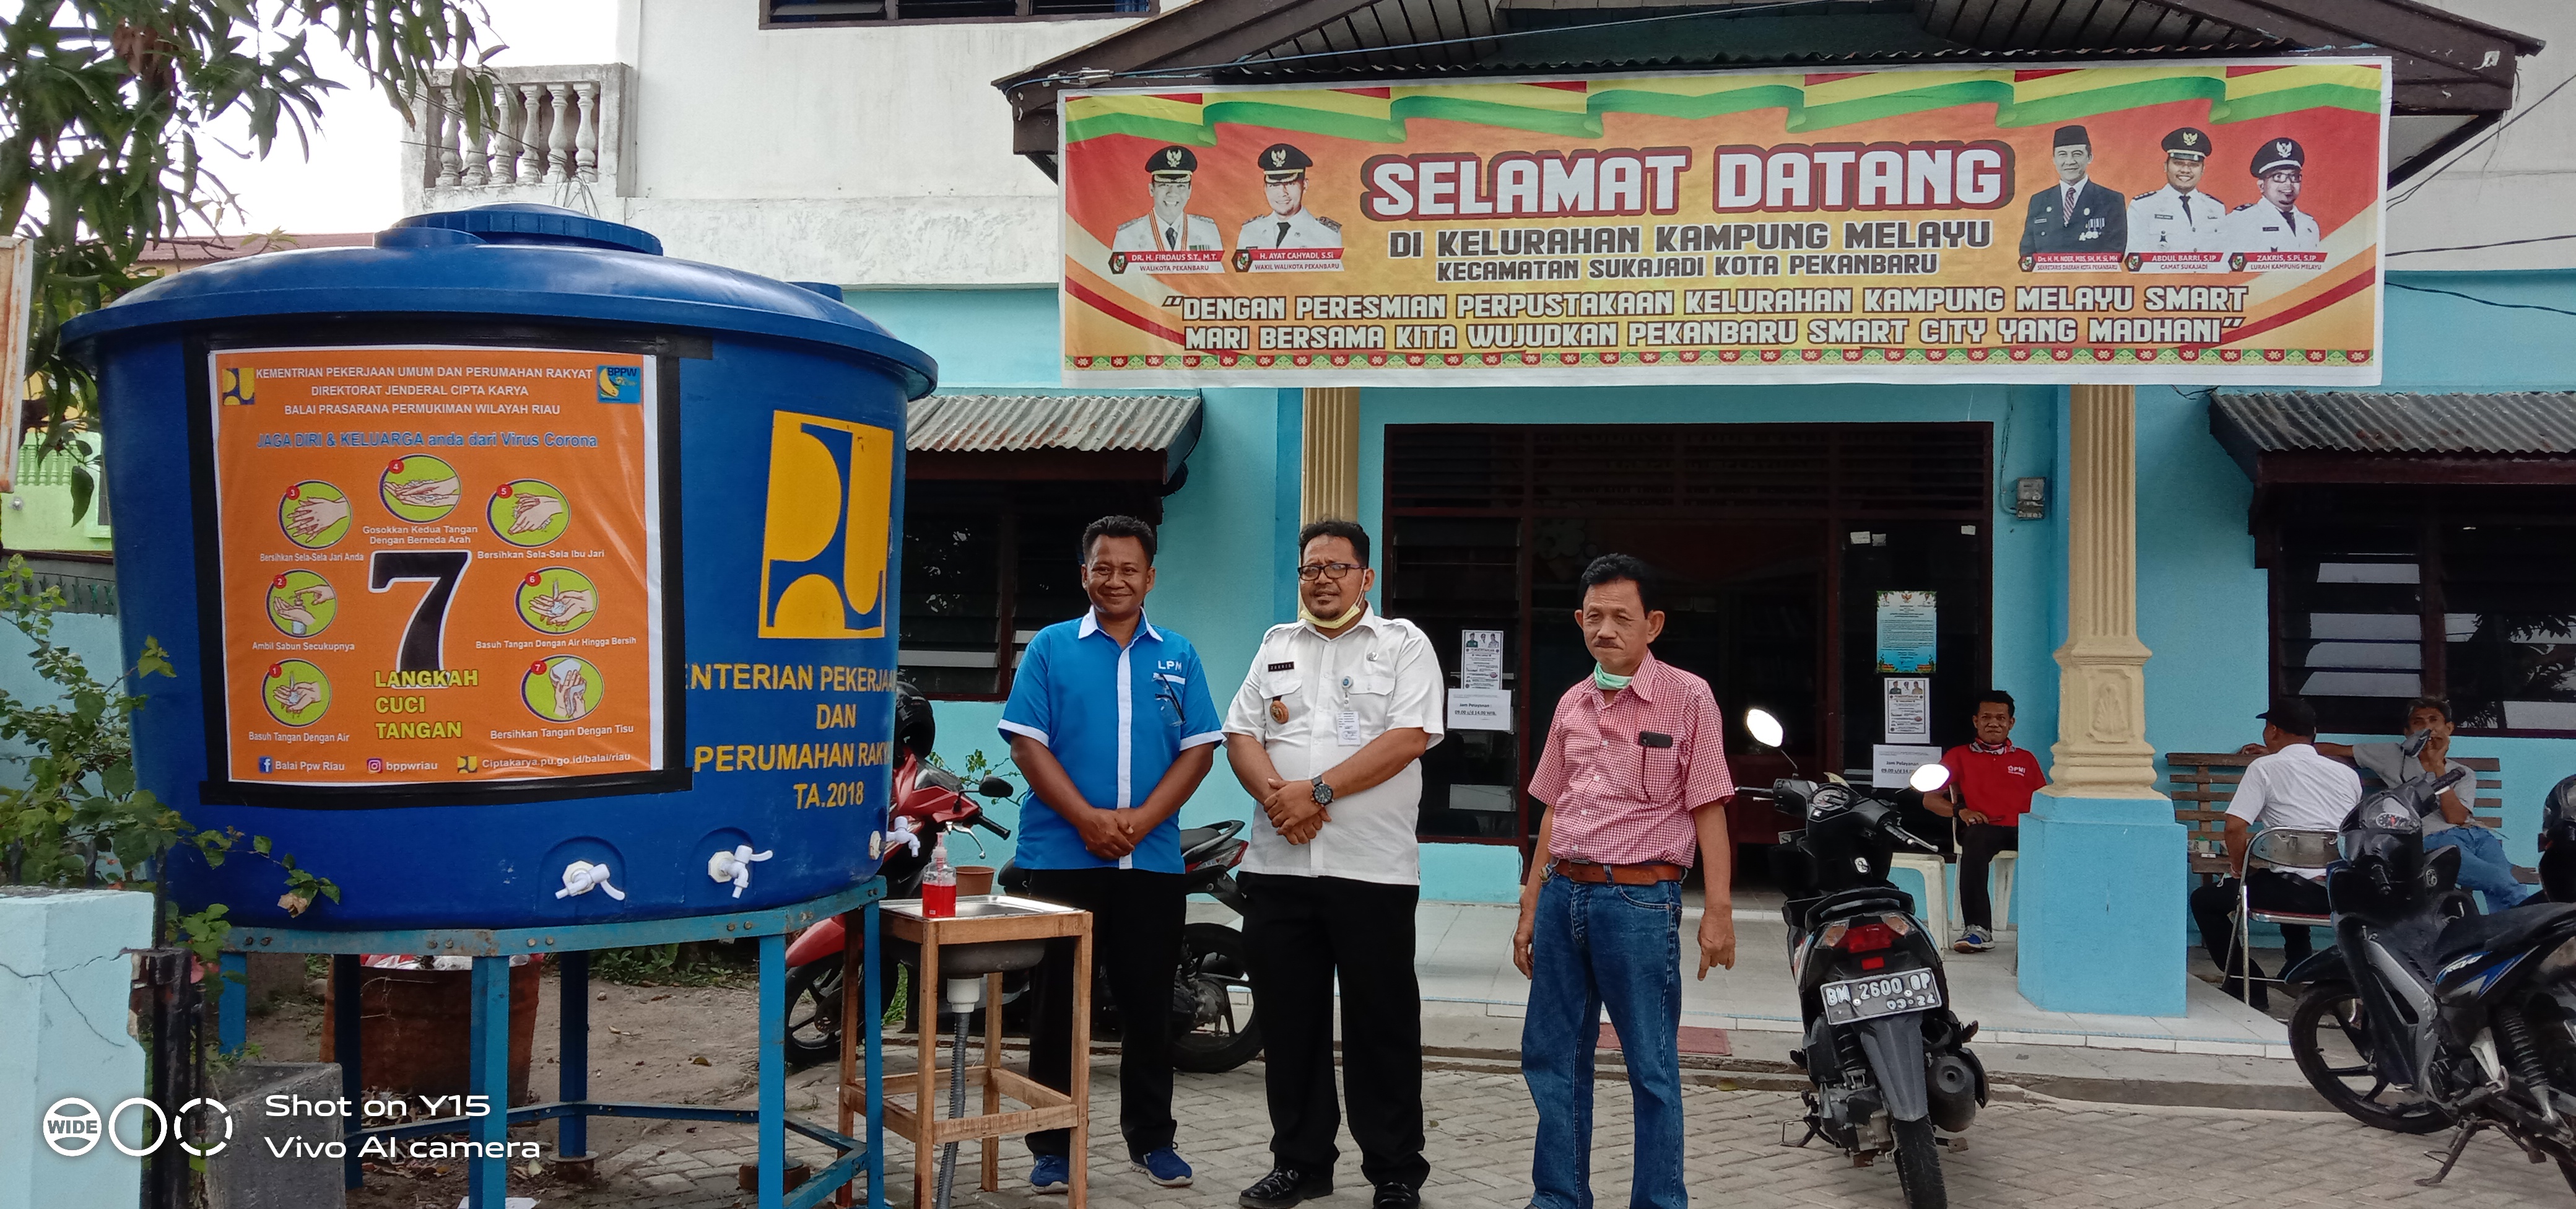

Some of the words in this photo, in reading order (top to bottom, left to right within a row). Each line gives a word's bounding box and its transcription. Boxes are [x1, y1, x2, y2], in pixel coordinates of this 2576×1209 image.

[1368, 151, 1688, 218] SELAMAT
[1718, 145, 2005, 211] DATANG
[1390, 232, 1422, 258] DI
[1438, 228, 1650, 256] KELURAHAN
[1657, 223, 1829, 253] KAMPUNG
[1844, 220, 1991, 249] MELAYU
[1287, 251, 1320, 260] CAHYADI,
[2178, 255, 2202, 263] BARRI,
[1437, 260, 1578, 282] KECAMATAN
[1588, 256, 1704, 279] SUKAJADI
[1714, 255, 1781, 276] KOTA
[1788, 252, 1938, 274] PEKANBARU
[1294, 293, 1447, 320] PERESMIAN
[1456, 290, 1674, 318] PERPUSTAKAAN
[1684, 287, 1853, 316] KELURAHAN
[1864, 287, 2004, 313] KAMPUNG
[2015, 285, 2134, 313] MELAYU
[2144, 284, 2248, 312] SMART
[1184, 324, 1250, 351] MARI
[1260, 323, 1386, 351] BERSAMA
[1395, 322, 1457, 349] KITA
[1466, 321, 1618, 349] WUJUDKAN
[1627, 318, 1799, 347] PEKANBARU
[1807, 318, 1912, 346] SMART
[1918, 317, 1988, 344] CITY
[1996, 316, 2077, 344] YANG
[256, 368, 323, 378] KEMENTRIAN
[325, 367, 395, 378] PEKERJAAN
[397, 367, 434, 378] UMUM
[437, 367, 463, 378] DAN
[465, 367, 543, 378] PERUMAHAN
[546, 369, 593, 379] RAKYAT
[607, 367, 637, 377] BPPW
[311, 385, 382, 396] DIREKTORAT
[384, 385, 448, 396] JENDERAL
[450, 385, 486, 396] CIPTA
[487, 385, 529, 396] KARYA
[284, 404, 316, 415] BALAI
[319, 404, 389, 415] PRASARANA
[391, 404, 474, 414] PERMUKIMAN
[476, 404, 530, 414] WILAYAH
[531, 404, 561, 414] RIAU
[256, 434, 293, 448] JAGA
[295, 434, 324, 448] DIRI
[326, 434, 337, 447] &
[340, 432, 423, 447] KELUARGA
[428, 433, 464, 446] anda
[468, 433, 498, 446] dari
[500, 433, 542, 447] Virus
[544, 433, 597, 447] Corona
[362, 526, 409, 534] Gosokkan
[411, 525, 441, 533] Kedua
[442, 526, 478, 535] Tangan
[370, 536, 404, 546] Dengan
[260, 553, 294, 562] Bersihkan
[294, 554, 328, 562] Sela-Sela
[329, 554, 342, 562] Jari
[477, 551, 523, 559] Bersihkan
[526, 550, 568, 558] Sela-Sela
[368, 550, 473, 689] 7
[252, 642, 274, 650] Ambil
[276, 642, 301, 650] Sabun
[303, 642, 355, 652] Secukupnya
[476, 640, 502, 648] Basuh
[503, 640, 533, 650] Tangan
[568, 639, 580, 647] Air
[581, 638, 610, 647] Hingga
[1158, 660, 1181, 673] LPM
[375, 670, 479, 688] LANGKAH
[685, 663, 813, 690] NTERIAN
[375, 696, 425, 713] CUCI
[816, 703, 856, 730] DAN
[248, 731, 271, 741] Basuh
[273, 732, 302, 743] Tangan
[303, 733, 335, 743] Dengan
[336, 733, 350, 741] Air
[375, 722, 462, 739] TANGAN
[490, 730, 538, 740] Bersihkan
[540, 728, 575, 738] Tangan
[577, 727, 612, 737] Dengan
[614, 725, 633, 733] Tisu
[482, 753, 632, 769] Ciptakarya.pu.go.id/balai/riau
[694, 742, 855, 772] PERUMAHAN
[275, 761, 298, 770] Balai
[300, 762, 321, 772] Ppw
[322, 761, 345, 770] Riau
[386, 761, 438, 772] bppwriau
[793, 781, 864, 810] TA.2018
[1826, 984, 1850, 1006] BM
[1859, 977, 1903, 1000] 2600
